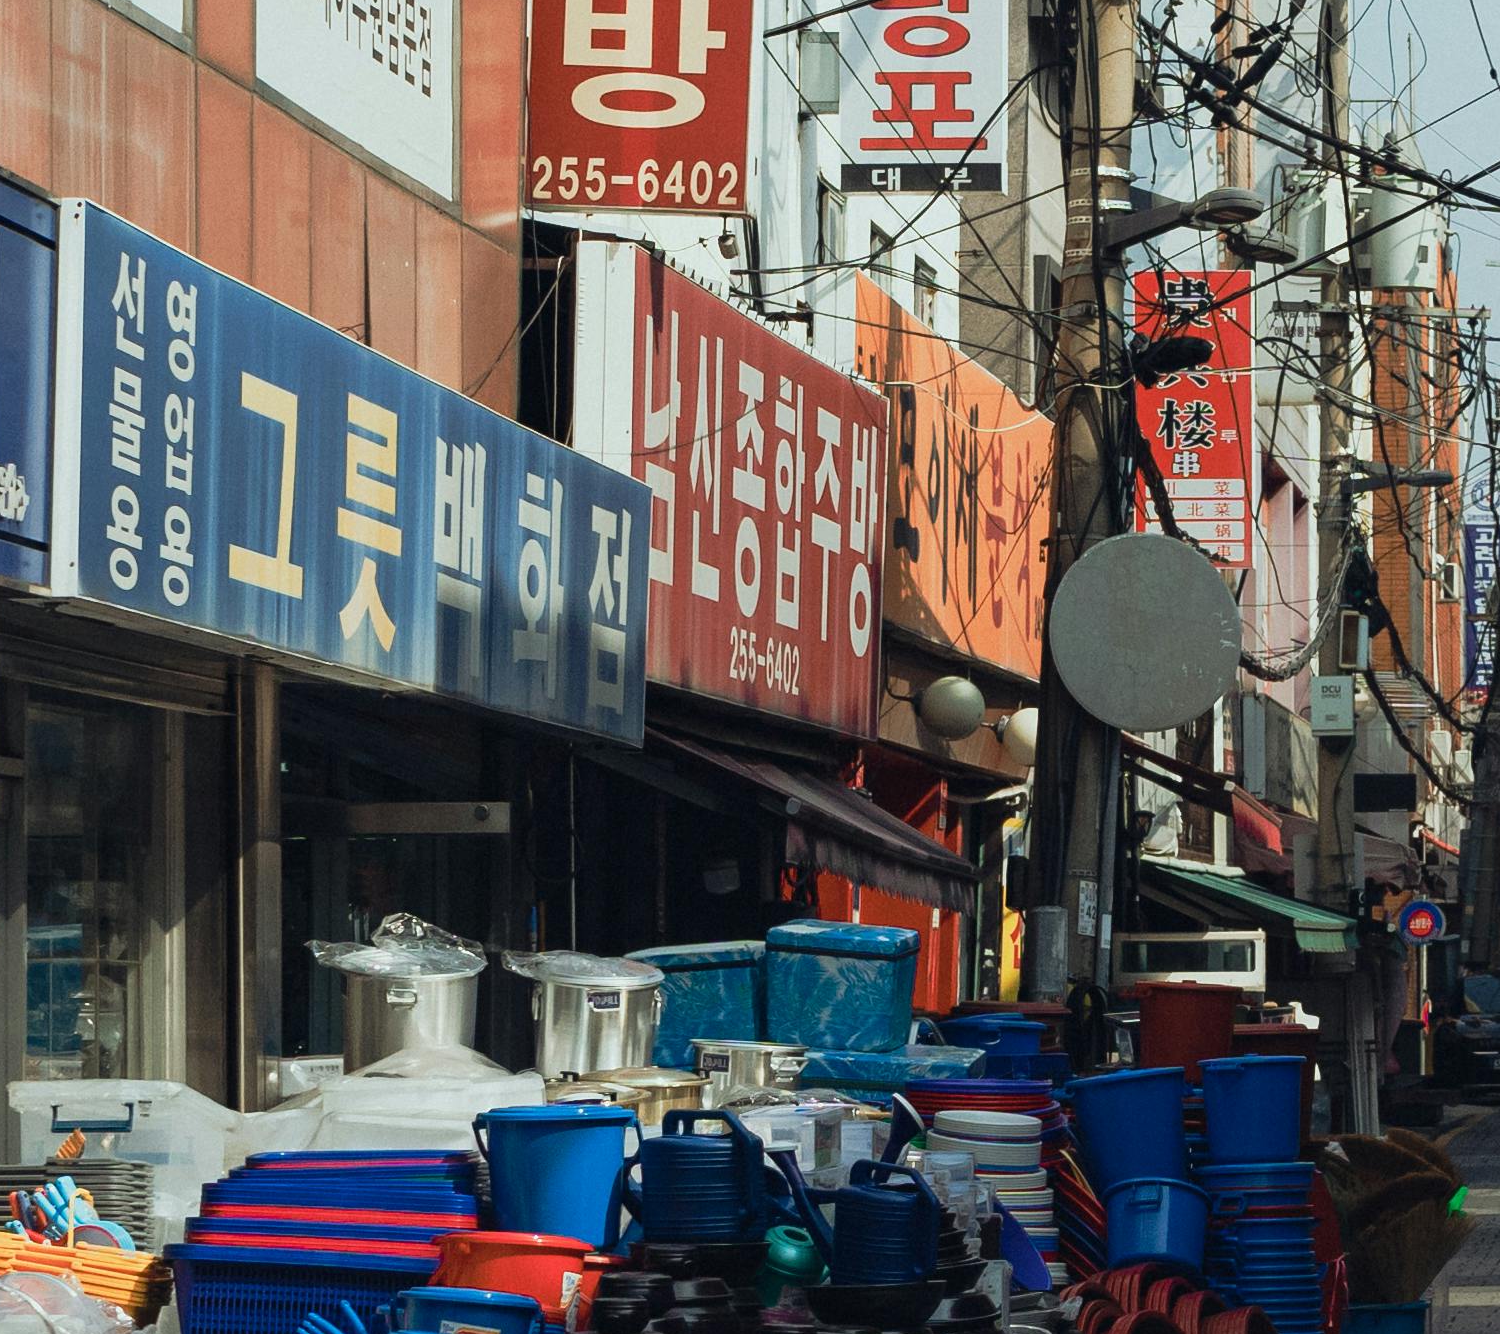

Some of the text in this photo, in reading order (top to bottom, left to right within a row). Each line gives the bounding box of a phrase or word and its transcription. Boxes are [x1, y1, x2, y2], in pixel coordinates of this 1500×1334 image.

[531, 154, 739, 205] 255-6402
[871, 165, 975, 192] 대부
[107, 252, 147, 591] 선물용
[163, 281, 196, 607] 영업용
[644, 310, 878, 658] 남신종합주방
[730, 626, 800, 695] 255-6402
[1321, 685, 1341, 694] DCU
